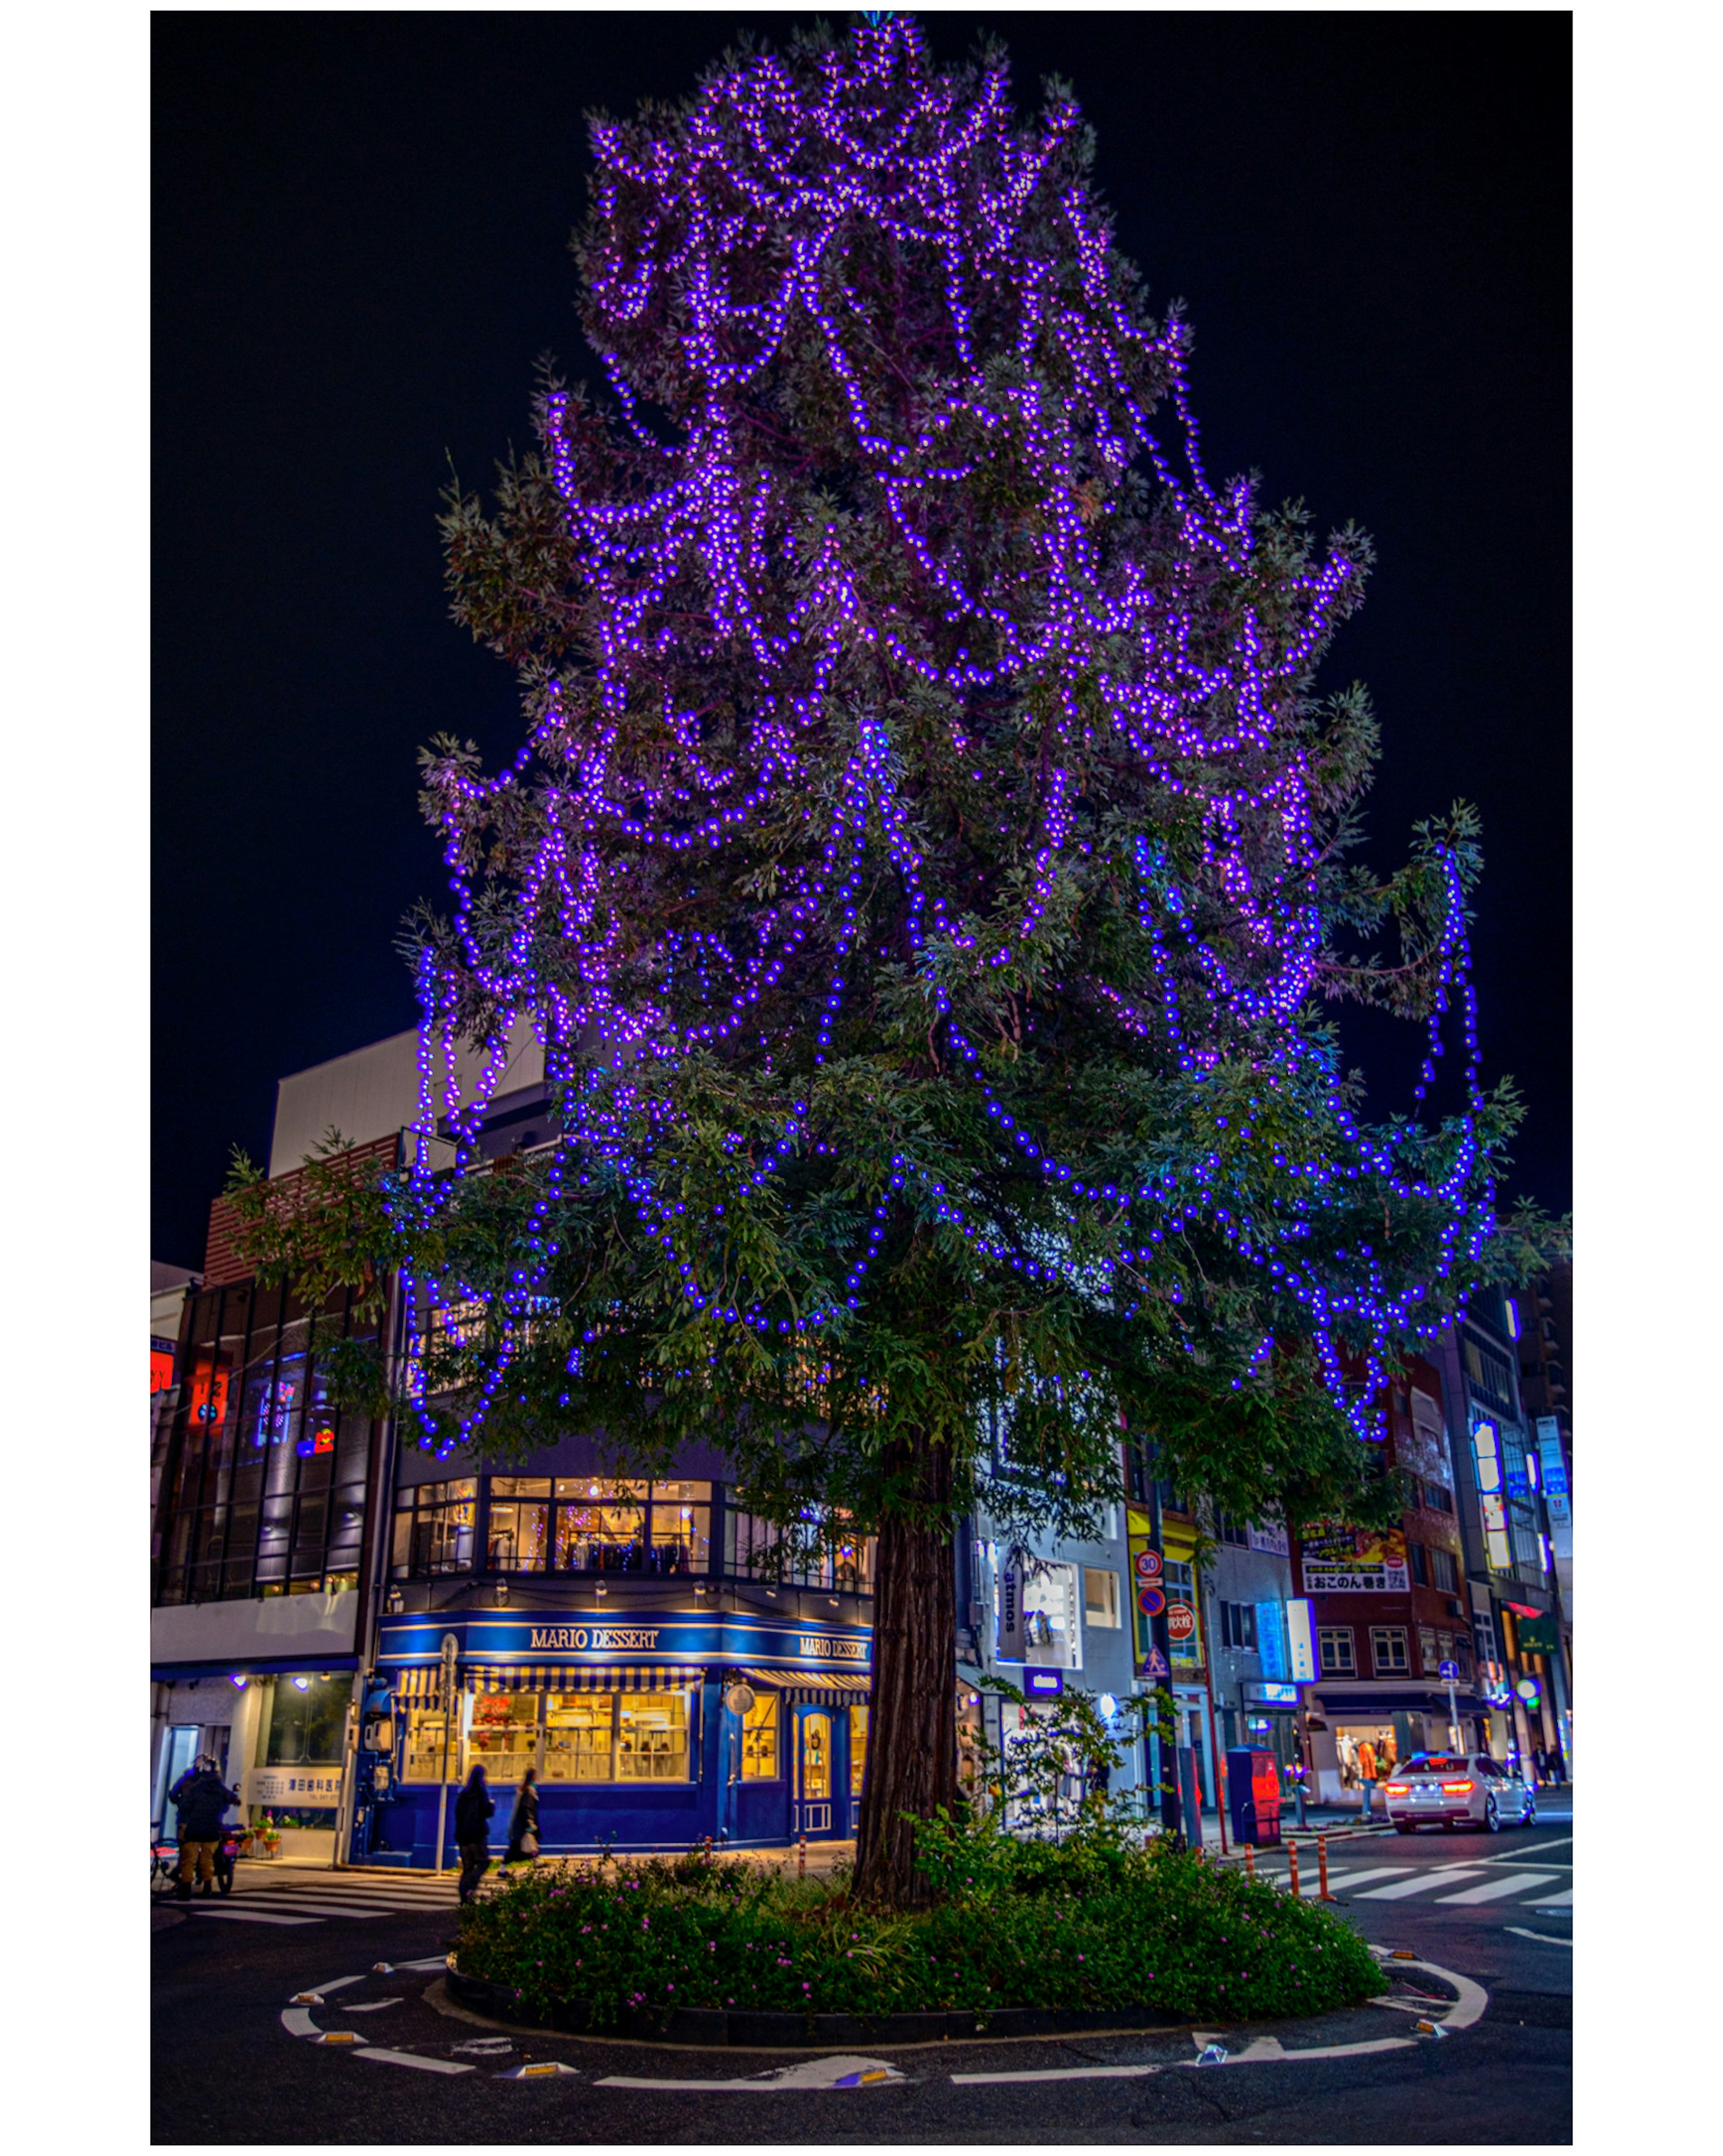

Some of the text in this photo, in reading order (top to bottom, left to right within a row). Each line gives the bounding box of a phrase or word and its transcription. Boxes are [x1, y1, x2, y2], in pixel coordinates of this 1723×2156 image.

[1141, 1557, 1157, 1571] 30
[1004, 1572, 1016, 1633] atmos
[530, 1629, 659, 1649] MARIO DESSERT
[800, 1637, 868, 1660] MARIO DESSERT
